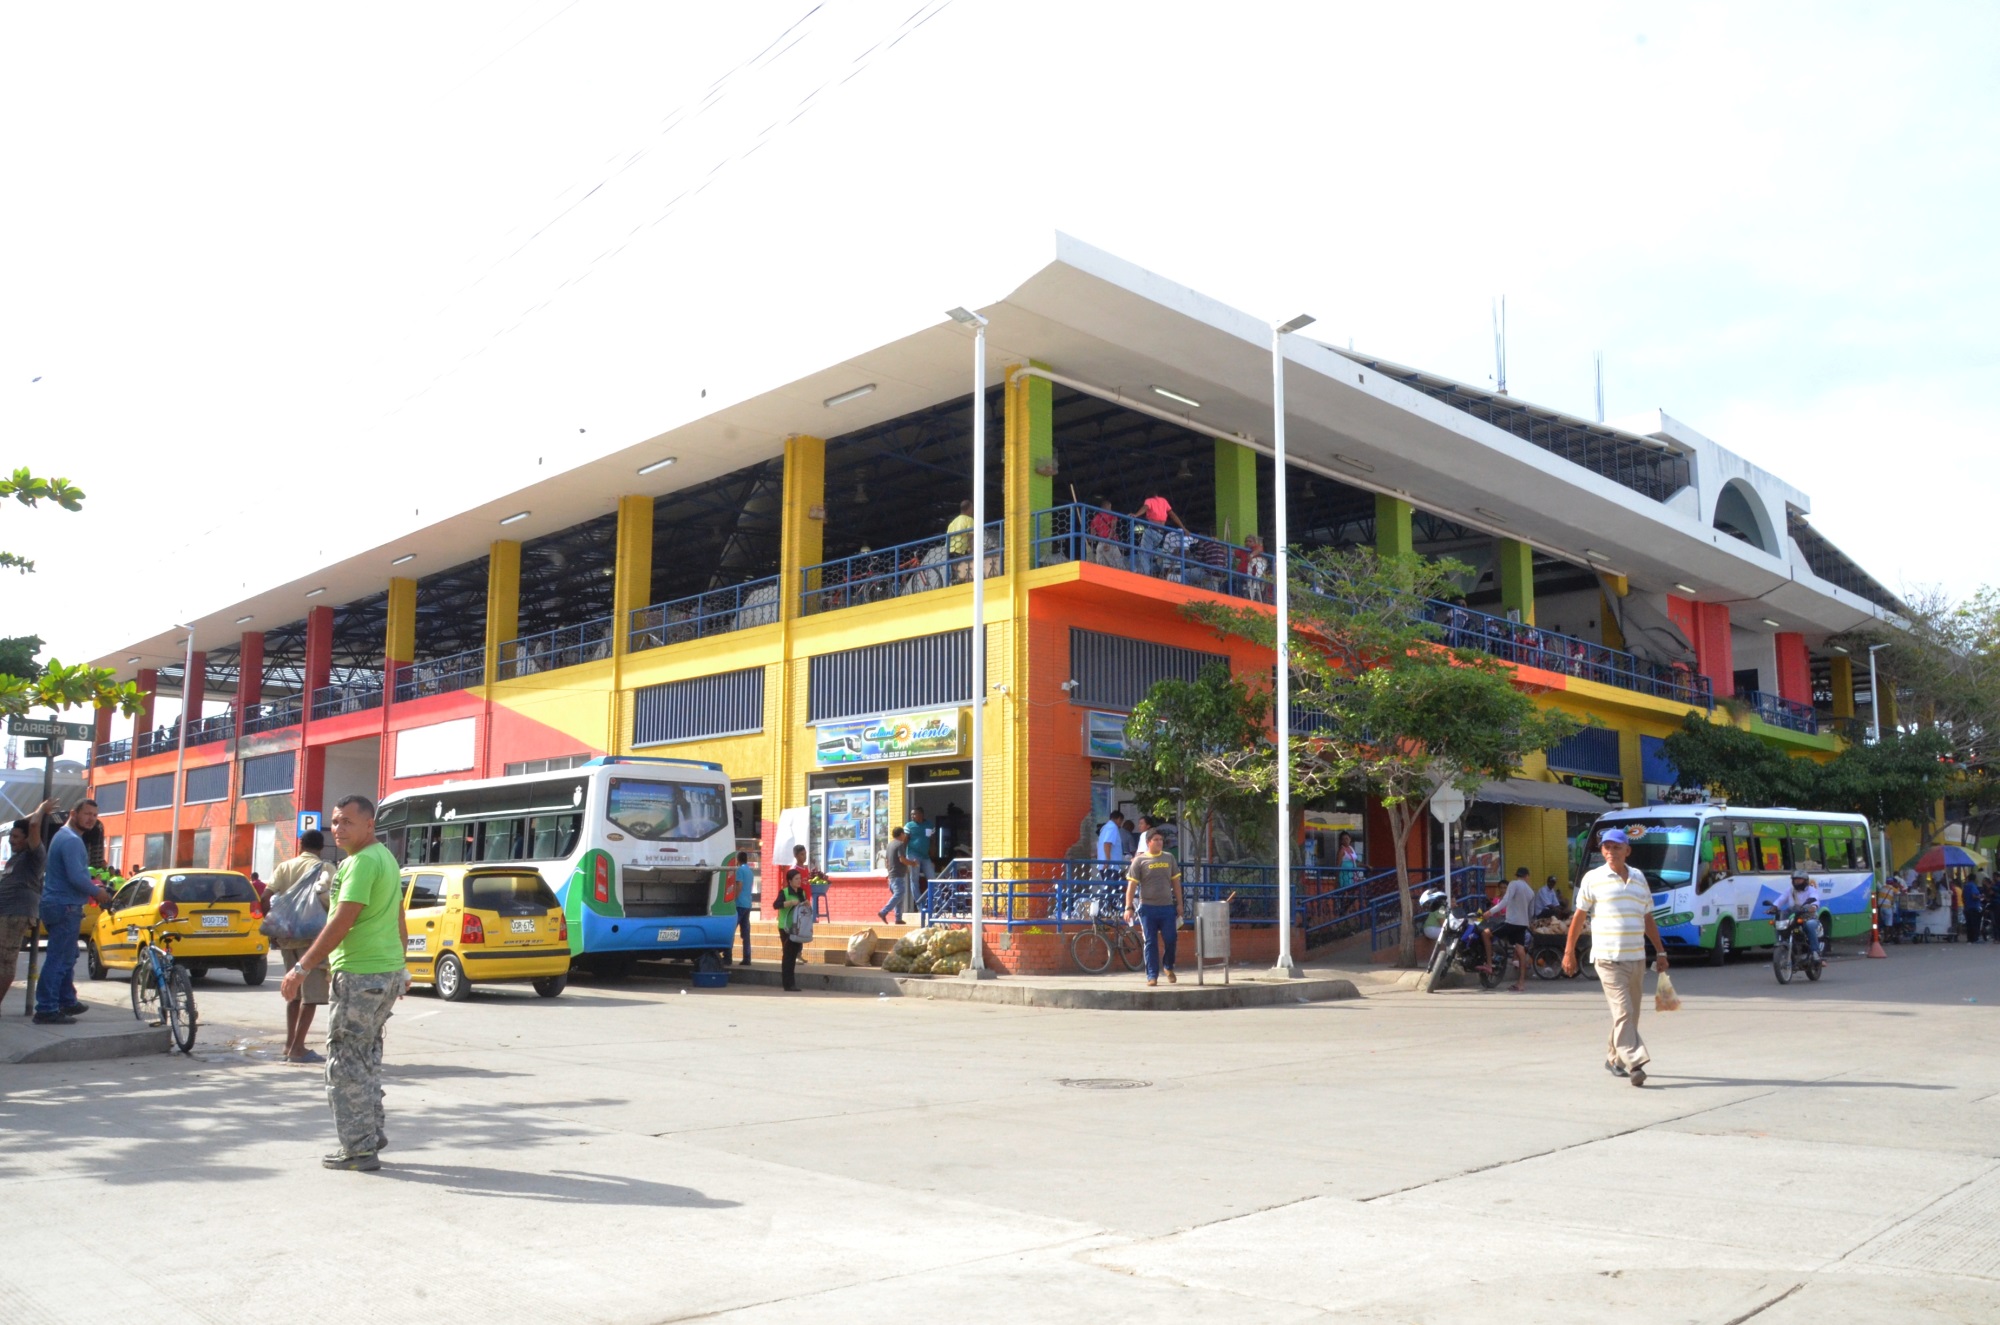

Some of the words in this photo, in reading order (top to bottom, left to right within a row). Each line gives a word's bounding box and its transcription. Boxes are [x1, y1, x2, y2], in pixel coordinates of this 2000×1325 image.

[13, 722, 67, 735] CARRERA
[78, 725, 89, 740] 9
[1572, 776, 1607, 790] Animal
[304, 816, 314, 830] P
[1148, 862, 1170, 870] adidas
